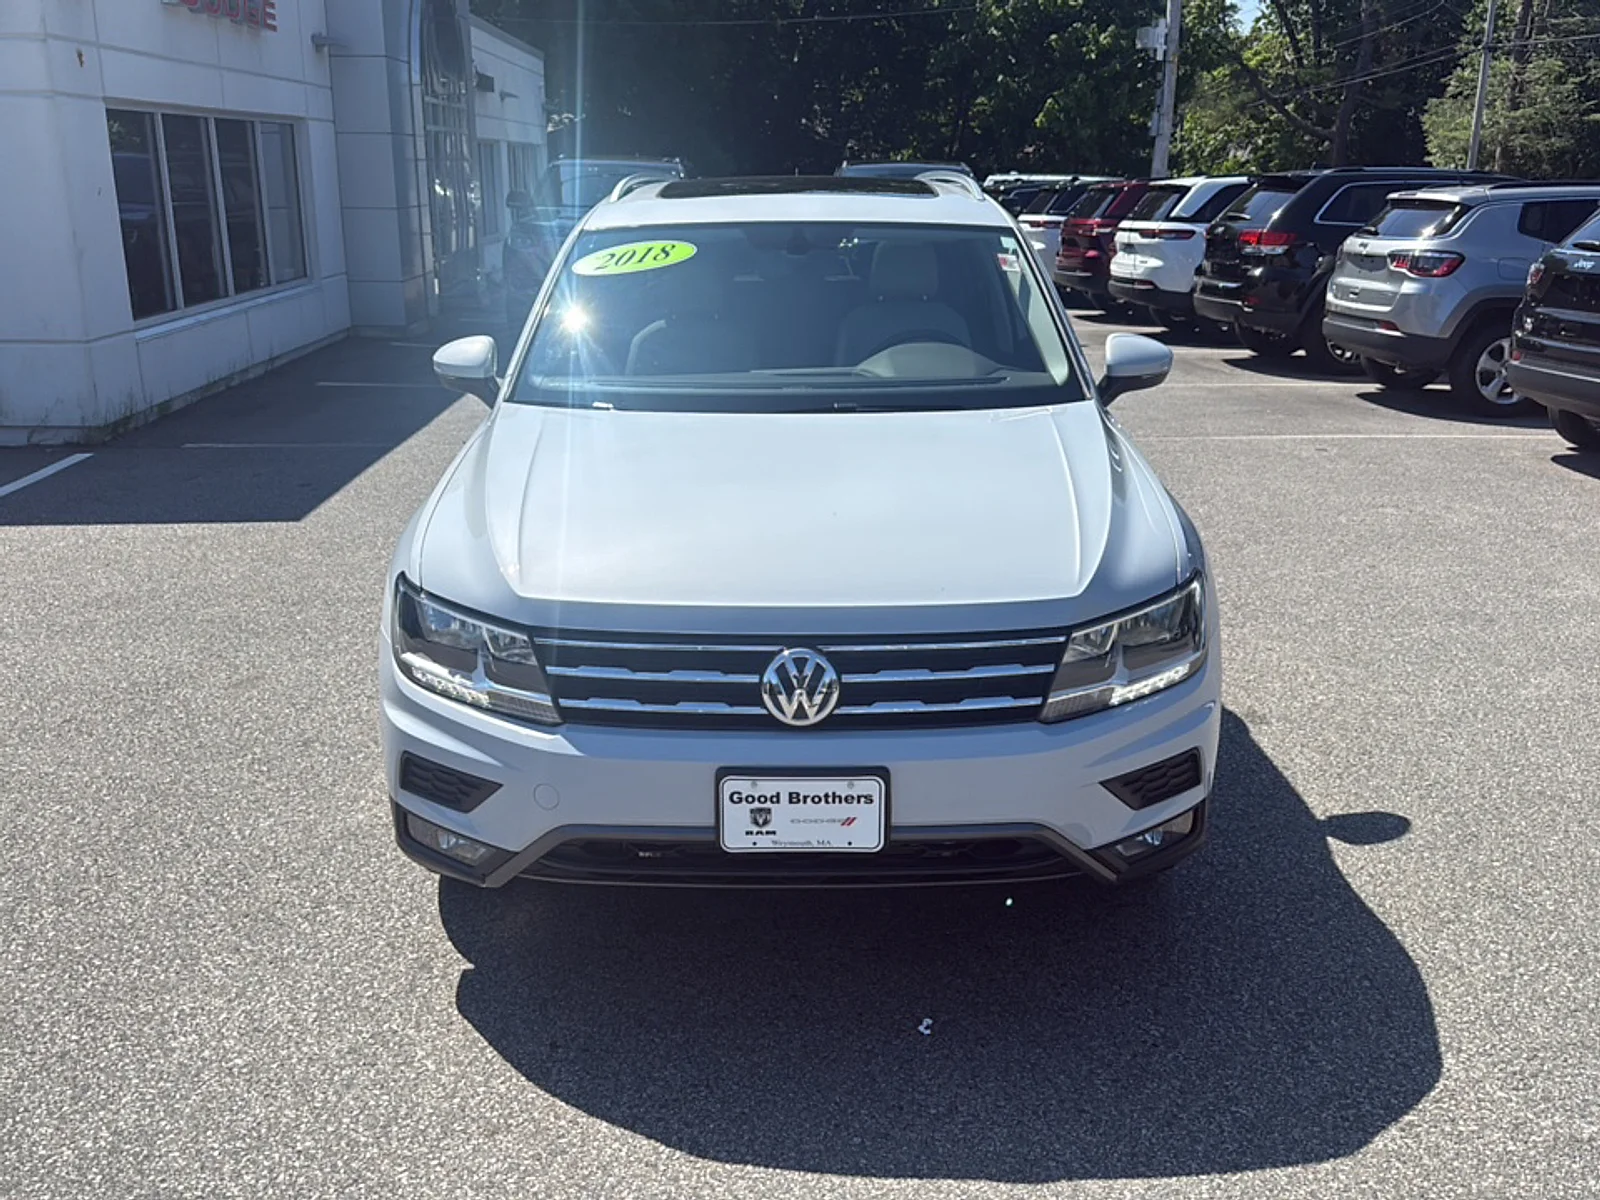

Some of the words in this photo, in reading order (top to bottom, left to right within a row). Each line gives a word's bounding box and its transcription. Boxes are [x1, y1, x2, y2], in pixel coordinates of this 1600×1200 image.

[178, 0, 278, 33] ODGE
[593, 243, 676, 271] 2018
[728, 791, 781, 805] Good
[788, 791, 875, 805] Brothers
